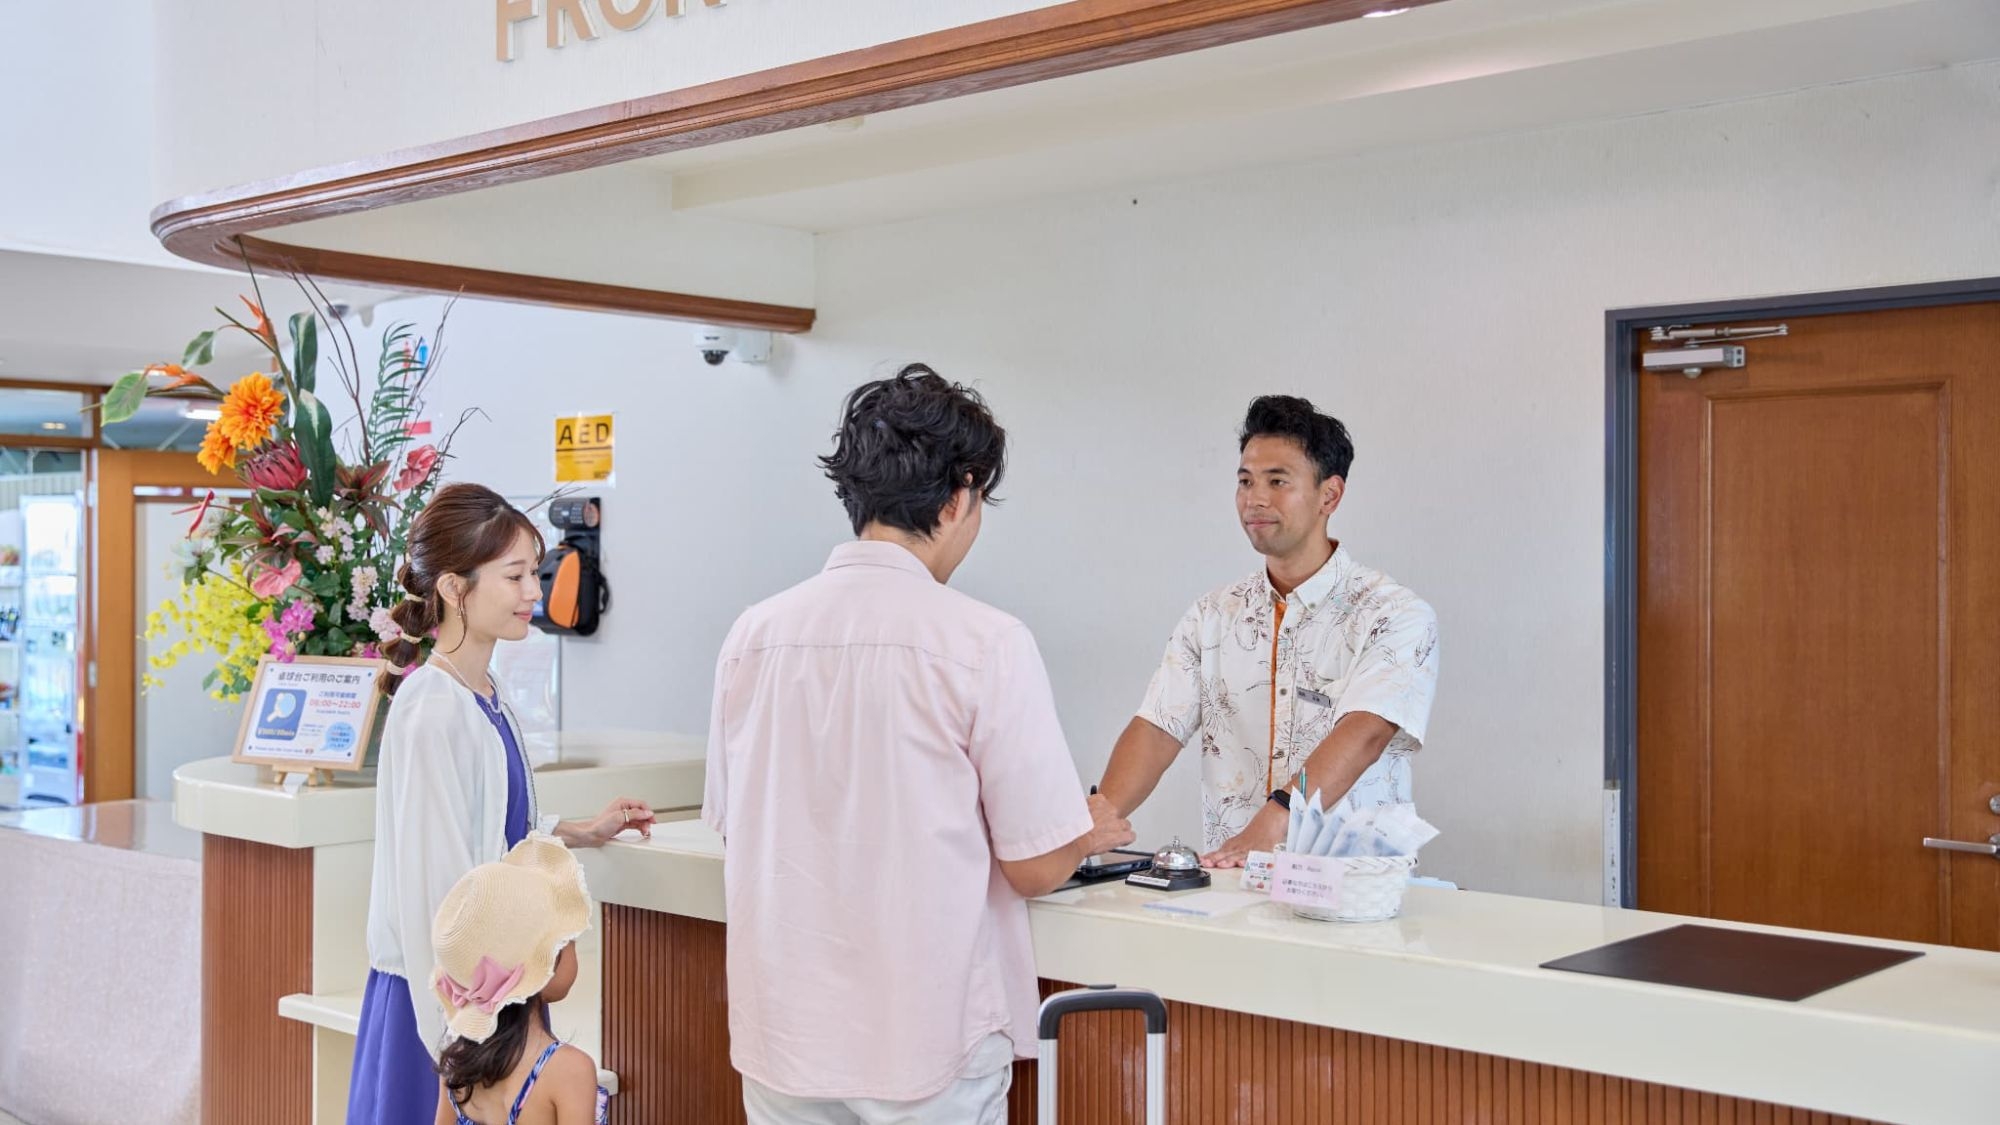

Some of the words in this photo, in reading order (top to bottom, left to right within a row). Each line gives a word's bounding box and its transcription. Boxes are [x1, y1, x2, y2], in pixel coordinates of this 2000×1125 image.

[558, 422, 610, 446] AED
[278, 671, 361, 685] 卓球台ご利用のご案内
